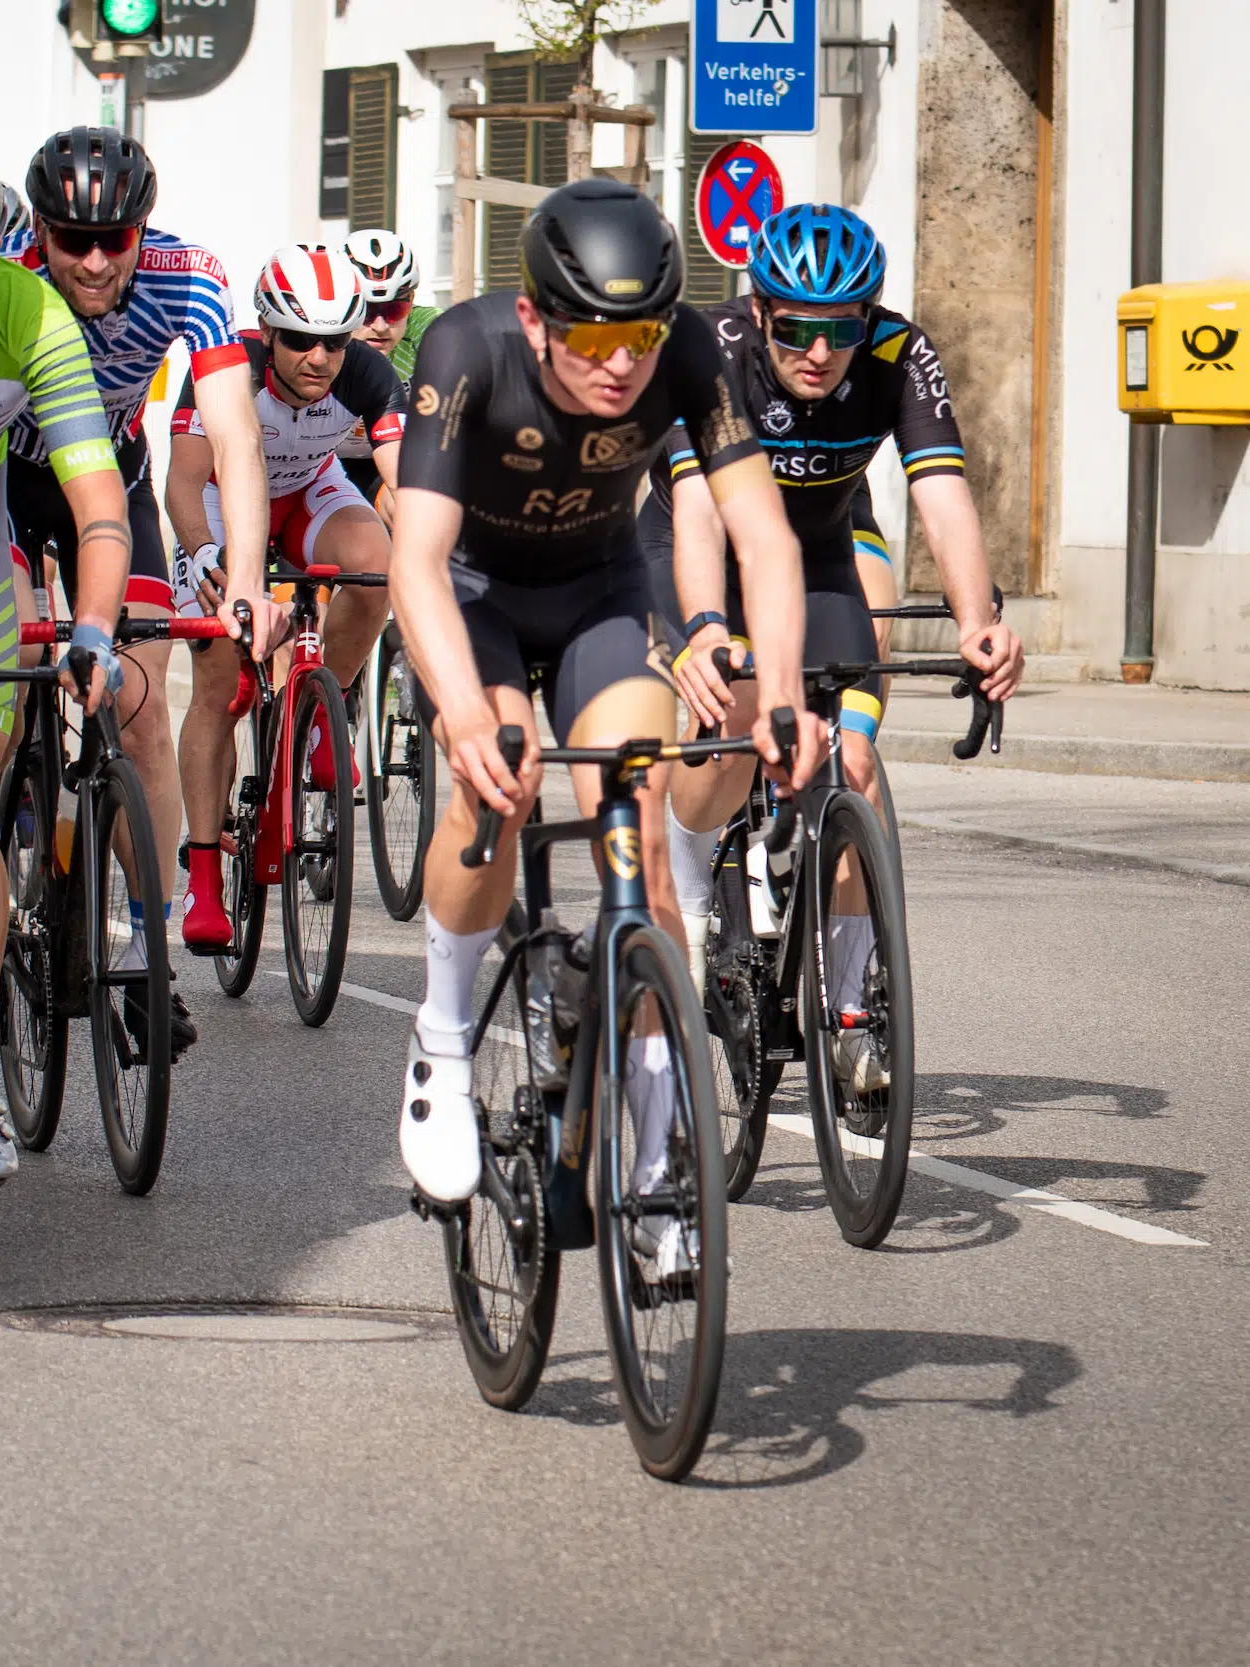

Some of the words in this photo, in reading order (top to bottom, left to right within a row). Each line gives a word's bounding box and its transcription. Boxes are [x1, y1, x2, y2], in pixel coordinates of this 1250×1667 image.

[705, 62, 806, 81] Verkehrs-
[724, 88, 782, 107] helfer
[144, 250, 226, 282] FORCHHEIM
[910, 335, 957, 419] MRSC
[374, 426, 399, 437] Team
[770, 454, 827, 477] RSC
